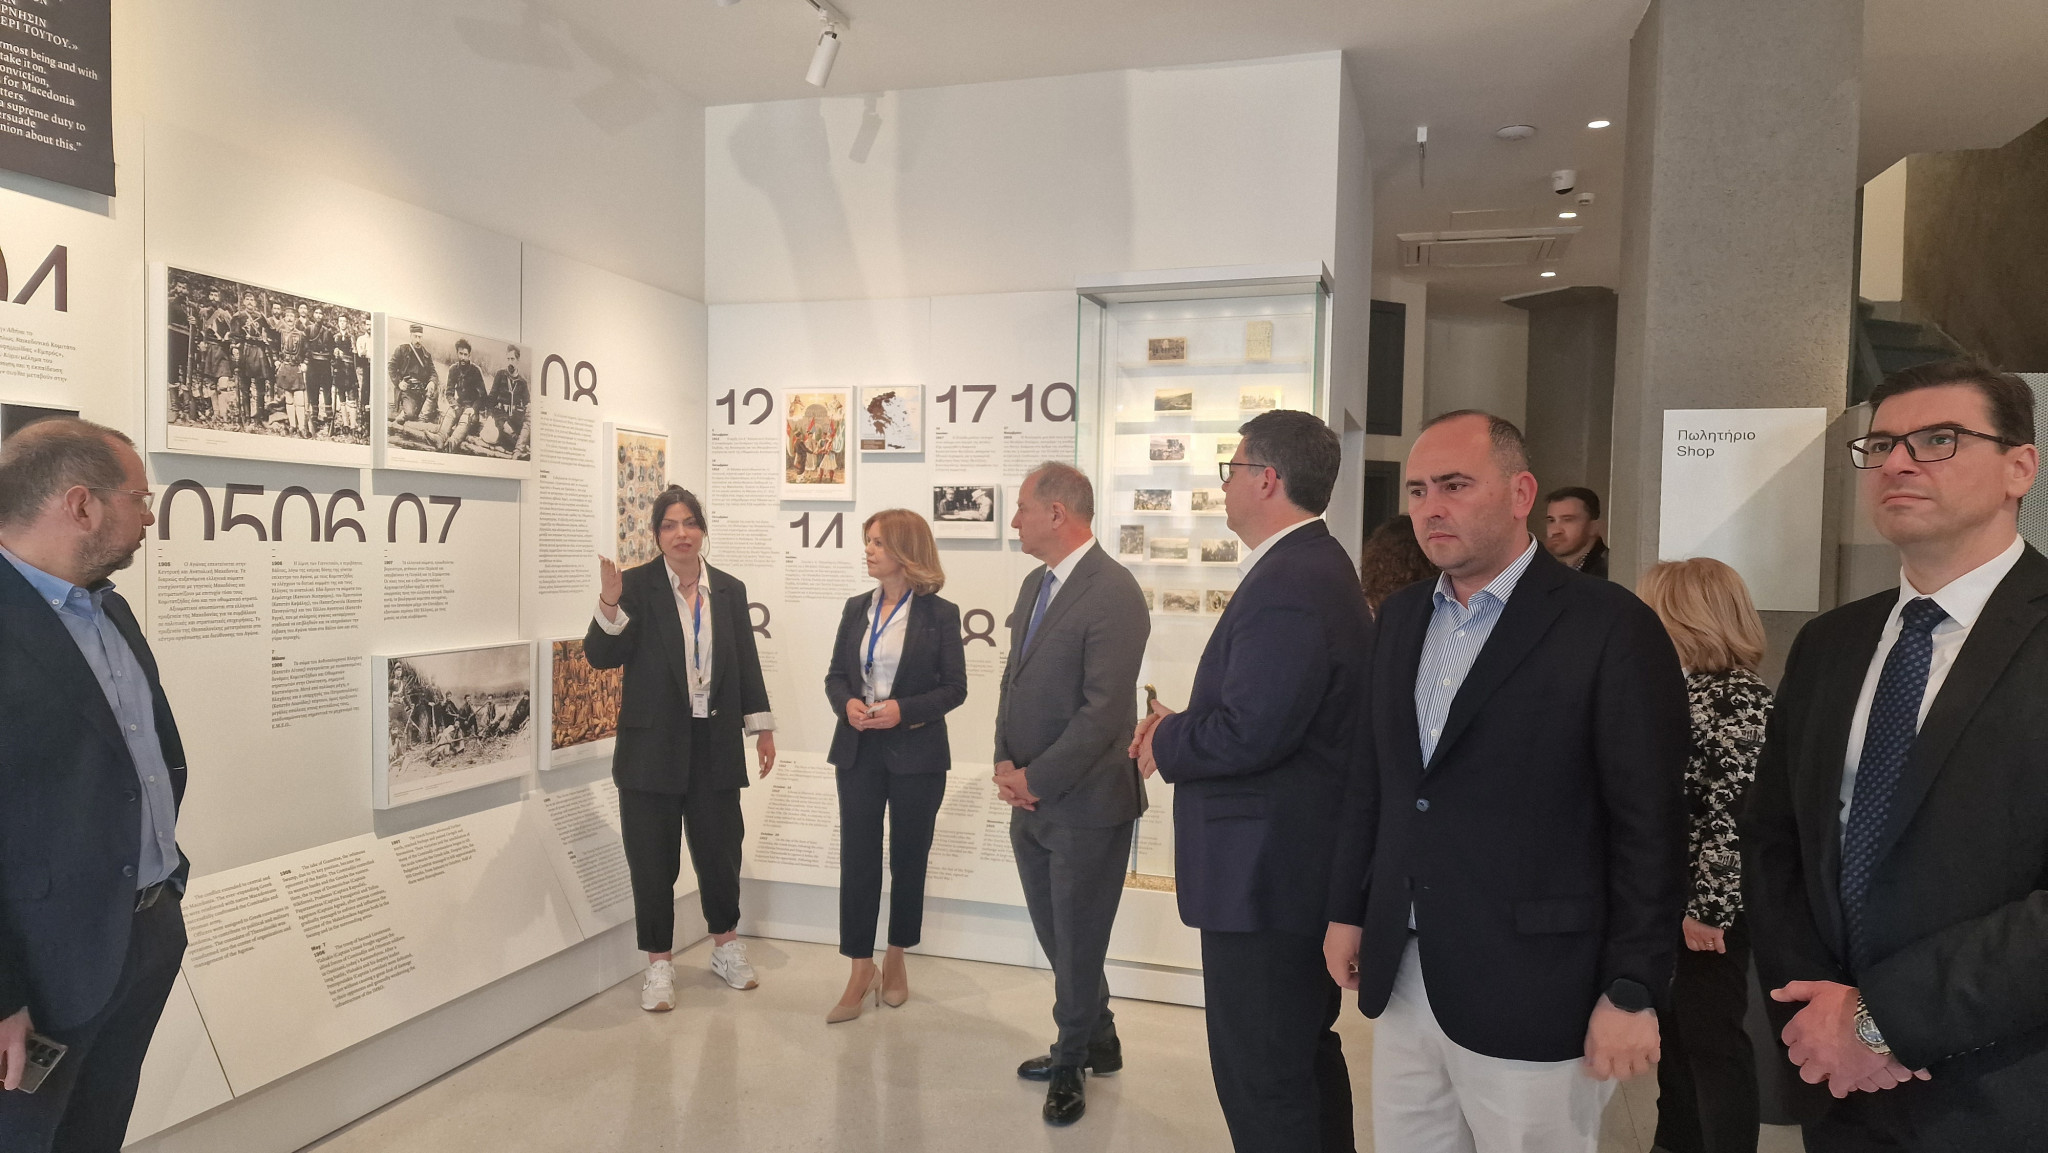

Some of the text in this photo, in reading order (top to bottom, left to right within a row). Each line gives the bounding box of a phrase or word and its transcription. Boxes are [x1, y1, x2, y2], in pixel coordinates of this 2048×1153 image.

[23, 23, 79, 51] ΤΟΥΤΟΥ.»
[0, 52, 47, 75] take it on.
[31, 49, 56, 69] being
[57, 59, 76, 74] and
[77, 66, 99, 80] with
[3, 75, 75, 106] for Macedonia
[6, 103, 50, 122] supreme
[51, 112, 74, 130] duty
[75, 121, 86, 132] to
[25, 130, 54, 145] about
[0, 243, 67, 312] 4
[715, 387, 774, 425] 12
[936, 384, 997, 423] 17
[1678, 429, 1756, 443] Πωλητήριο
[1677, 445, 1715, 459] Shop
[158, 479, 462, 544] 05 06 07
[960, 608, 996, 647] 8
